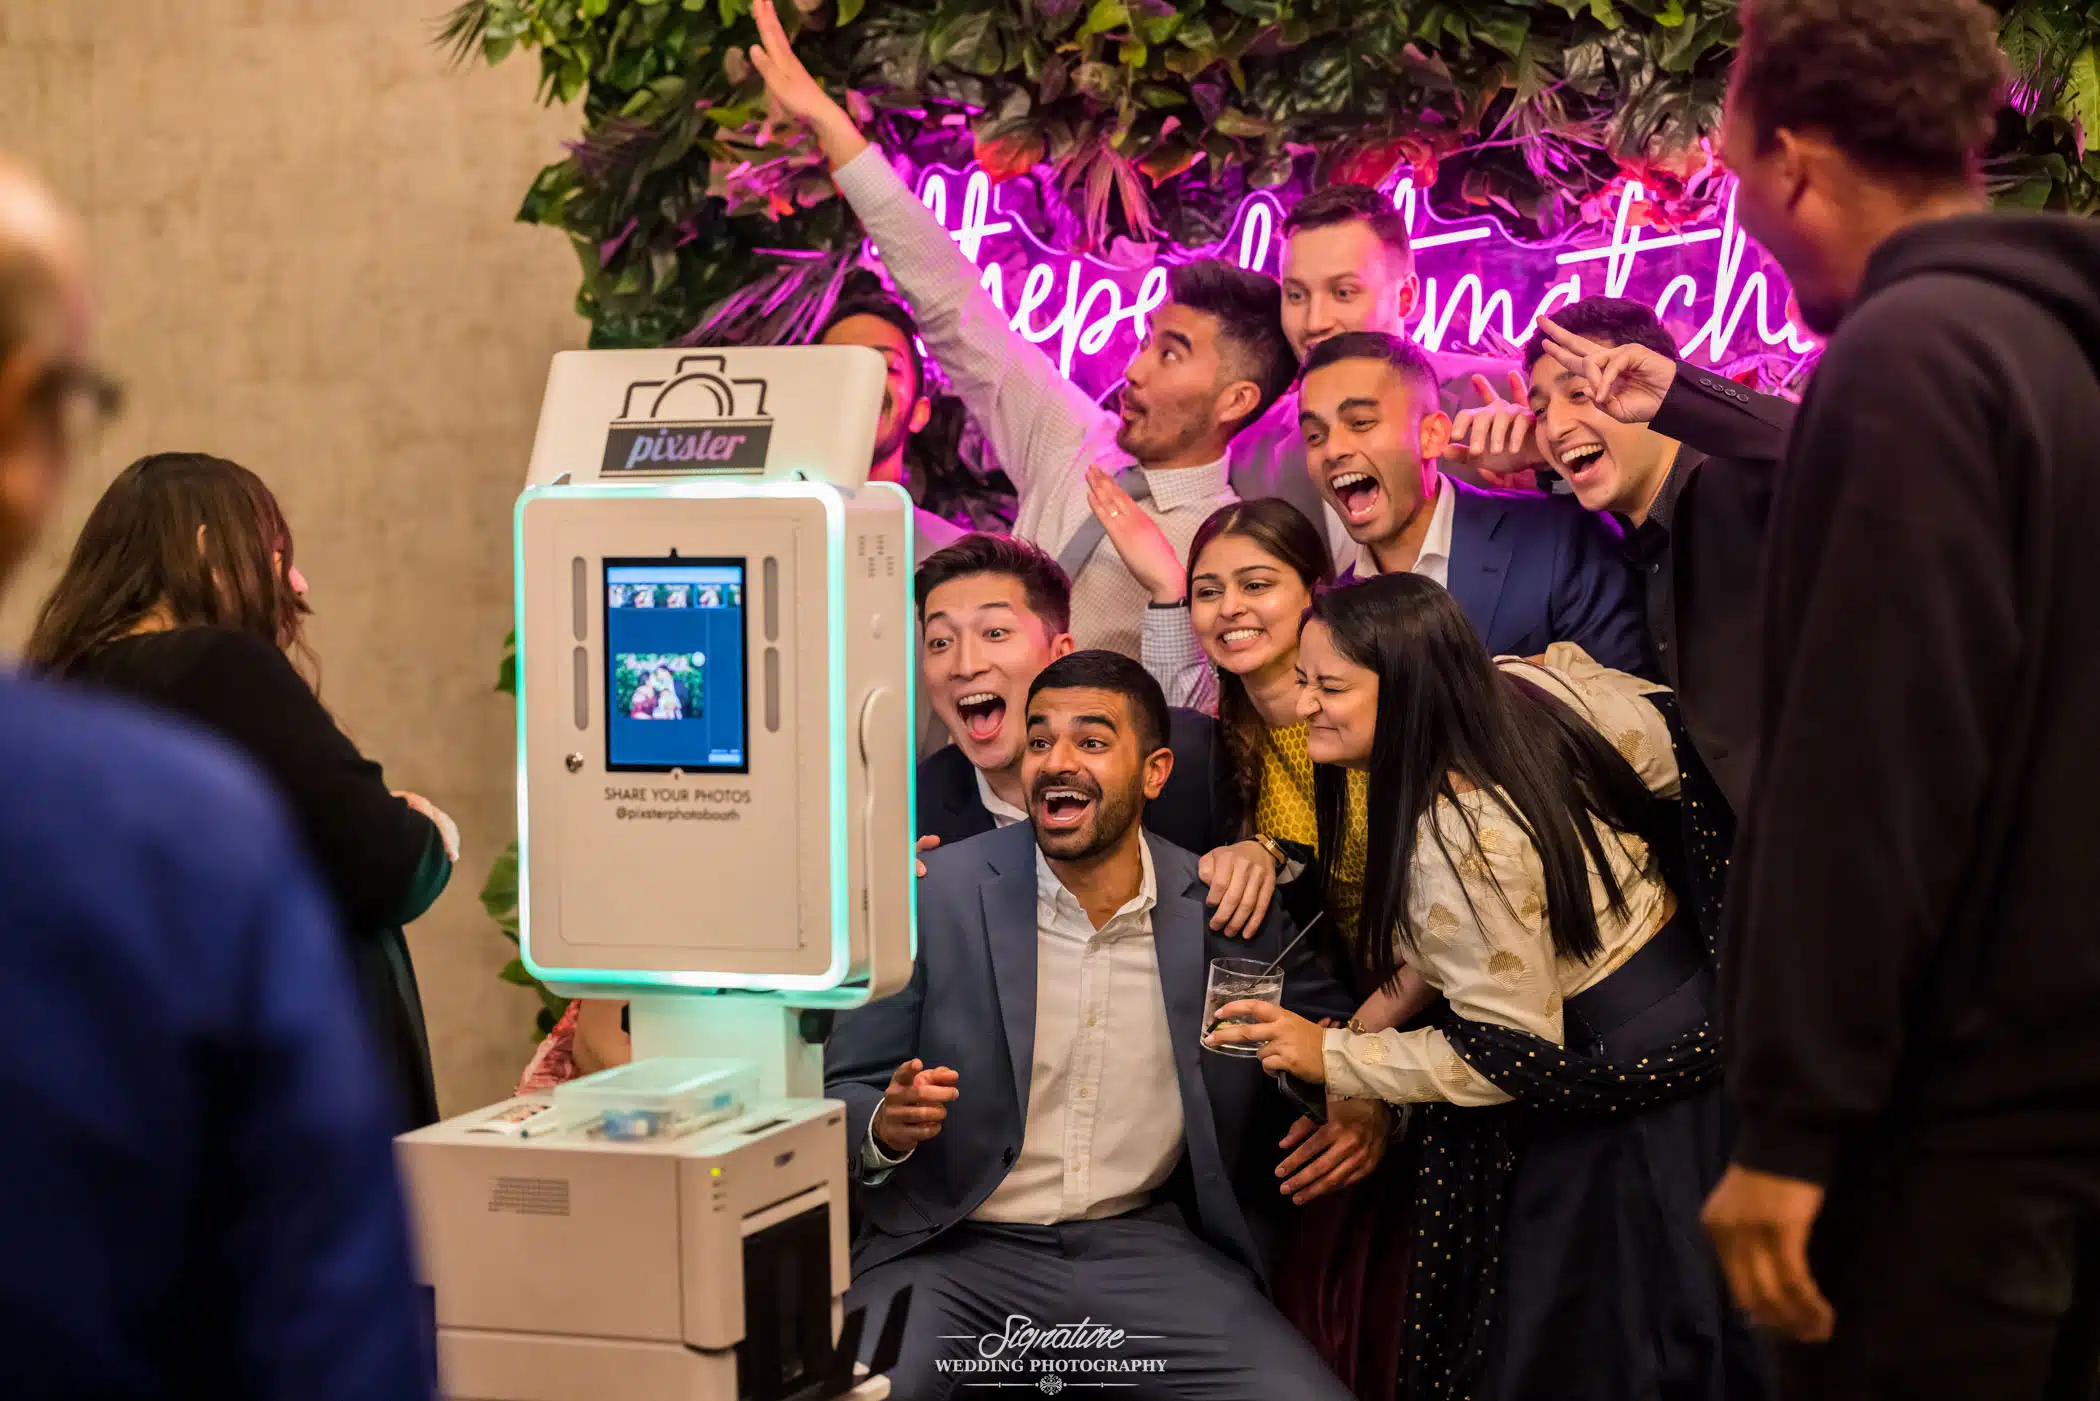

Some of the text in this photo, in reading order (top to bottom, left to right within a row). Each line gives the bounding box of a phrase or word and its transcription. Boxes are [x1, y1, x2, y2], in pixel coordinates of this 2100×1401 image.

[625, 427, 747, 469] pixster
[604, 787, 752, 804] SHARE YOUR PHOTOS
[616, 806, 740, 821] @pixsterphotobooth
